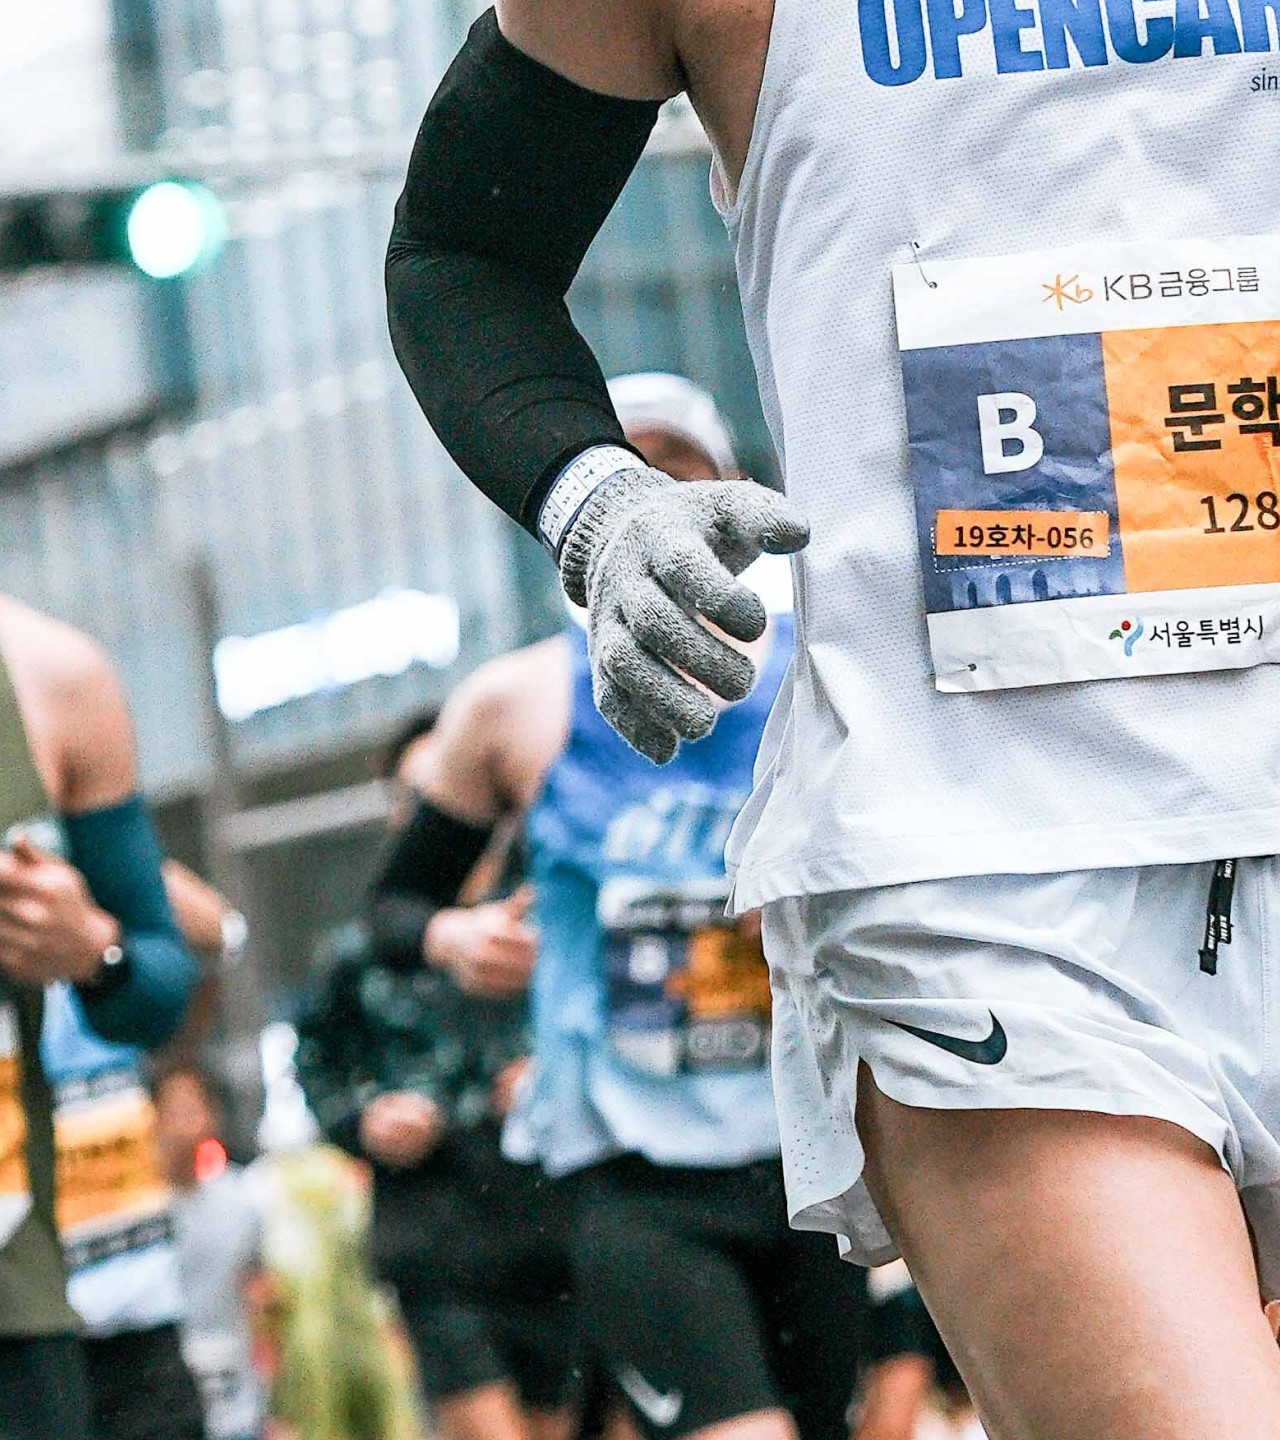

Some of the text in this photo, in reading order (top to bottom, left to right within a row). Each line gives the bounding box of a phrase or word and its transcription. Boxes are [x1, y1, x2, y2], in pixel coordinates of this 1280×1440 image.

[975, 390, 1046, 476] B
[952, 523, 1095, 551] 19호차-056
[1148, 615, 1265, 650] 서울특별시
